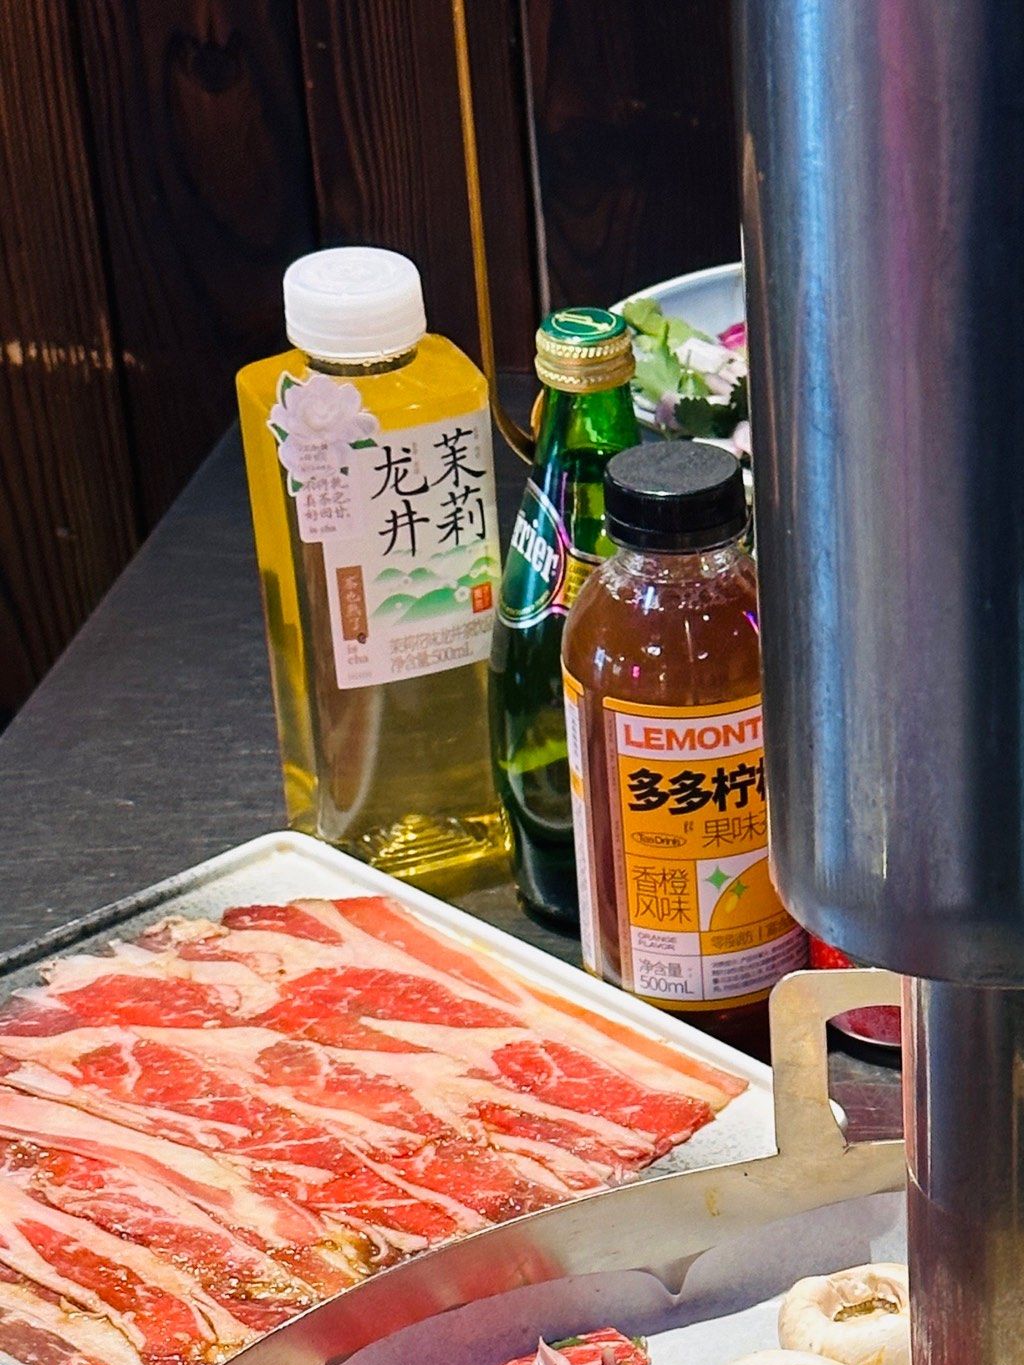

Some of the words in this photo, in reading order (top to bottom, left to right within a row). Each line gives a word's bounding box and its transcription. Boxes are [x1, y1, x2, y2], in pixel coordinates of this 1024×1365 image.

[371, 446, 430, 557] 龙井
[431, 428, 487, 547] 茉莉
[511, 509, 560, 583] rrier
[632, 865, 689, 897] 香橙
[635, 896, 691, 924] 风味
[640, 974, 695, 995] 500mL
